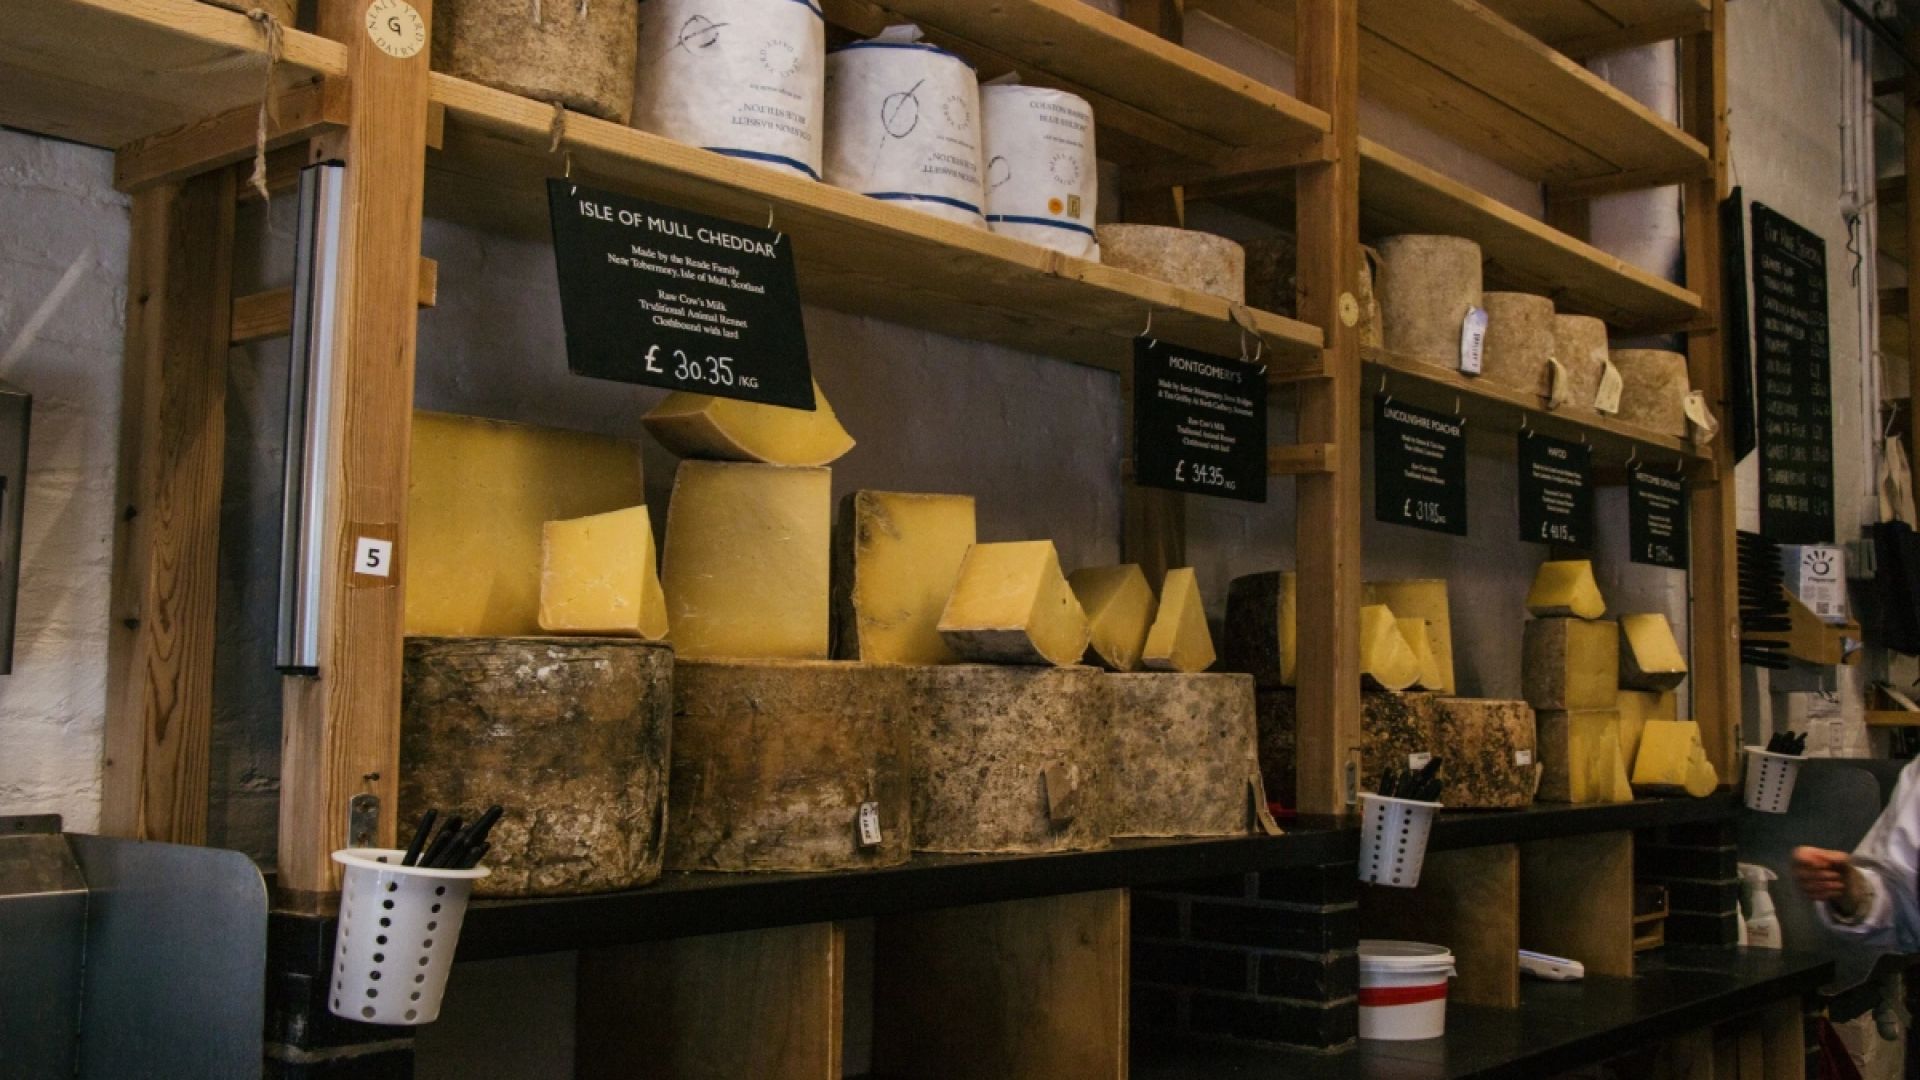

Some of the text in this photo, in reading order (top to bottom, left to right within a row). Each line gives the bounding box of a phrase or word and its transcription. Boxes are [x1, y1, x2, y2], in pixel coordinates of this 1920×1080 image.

[376, 38, 415, 56] DAIRY
[579, 200, 777, 259] ISLE OF MULL CHEDDAR
[631, 244, 656, 260] Made
[657, 250, 668, 264] by
[670, 252, 684, 266] the
[712, 261, 740, 278] Family
[680, 266, 696, 281] Isle
[697, 271, 707, 283] of
[730, 278, 765, 294] Scotland
[638, 298, 748, 328] Traditional Animal Rennet
[658, 288, 727, 312] Raw Cow's Milk
[652, 314, 740, 340] Clothbound with lard
[644, 344, 760, 390] £ 30.35 /KG
[1176, 460, 1184, 482] £
[366, 548, 380, 568] 5
